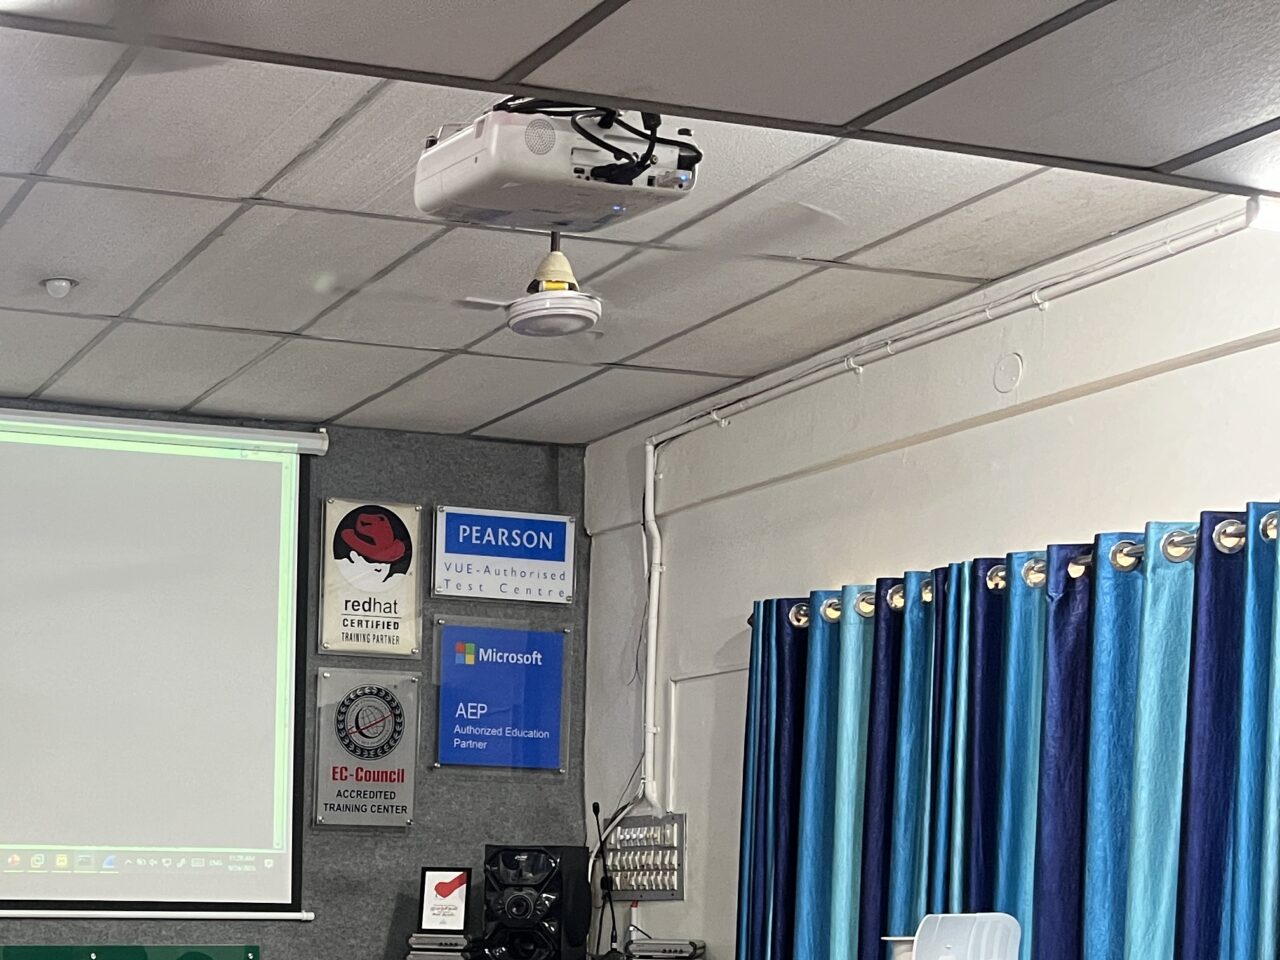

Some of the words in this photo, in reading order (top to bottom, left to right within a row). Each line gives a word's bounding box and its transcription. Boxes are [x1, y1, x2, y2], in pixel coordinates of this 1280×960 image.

[459, 525, 553, 550] PEARSON
[444, 562, 565, 581] VUE-Authorised
[444, 578, 484, 592] Test
[500, 583, 565, 598] Centre
[344, 597, 398, 614] redhat
[342, 618, 400, 630] CERTIFIED
[342, 632, 371, 644] TRAINING
[372, 634, 400, 645] PARTNER
[479, 648, 542, 666] Microsoft
[456, 703, 488, 719] AEP
[454, 725, 502, 737] Authorized
[506, 727, 550, 739] Education
[454, 739, 487, 750] Partner
[332, 766, 405, 783] EC-Council
[336, 789, 396, 800] ACCREDITED
[324, 802, 367, 813] TRAINING
[370, 803, 407, 814] CENTER
